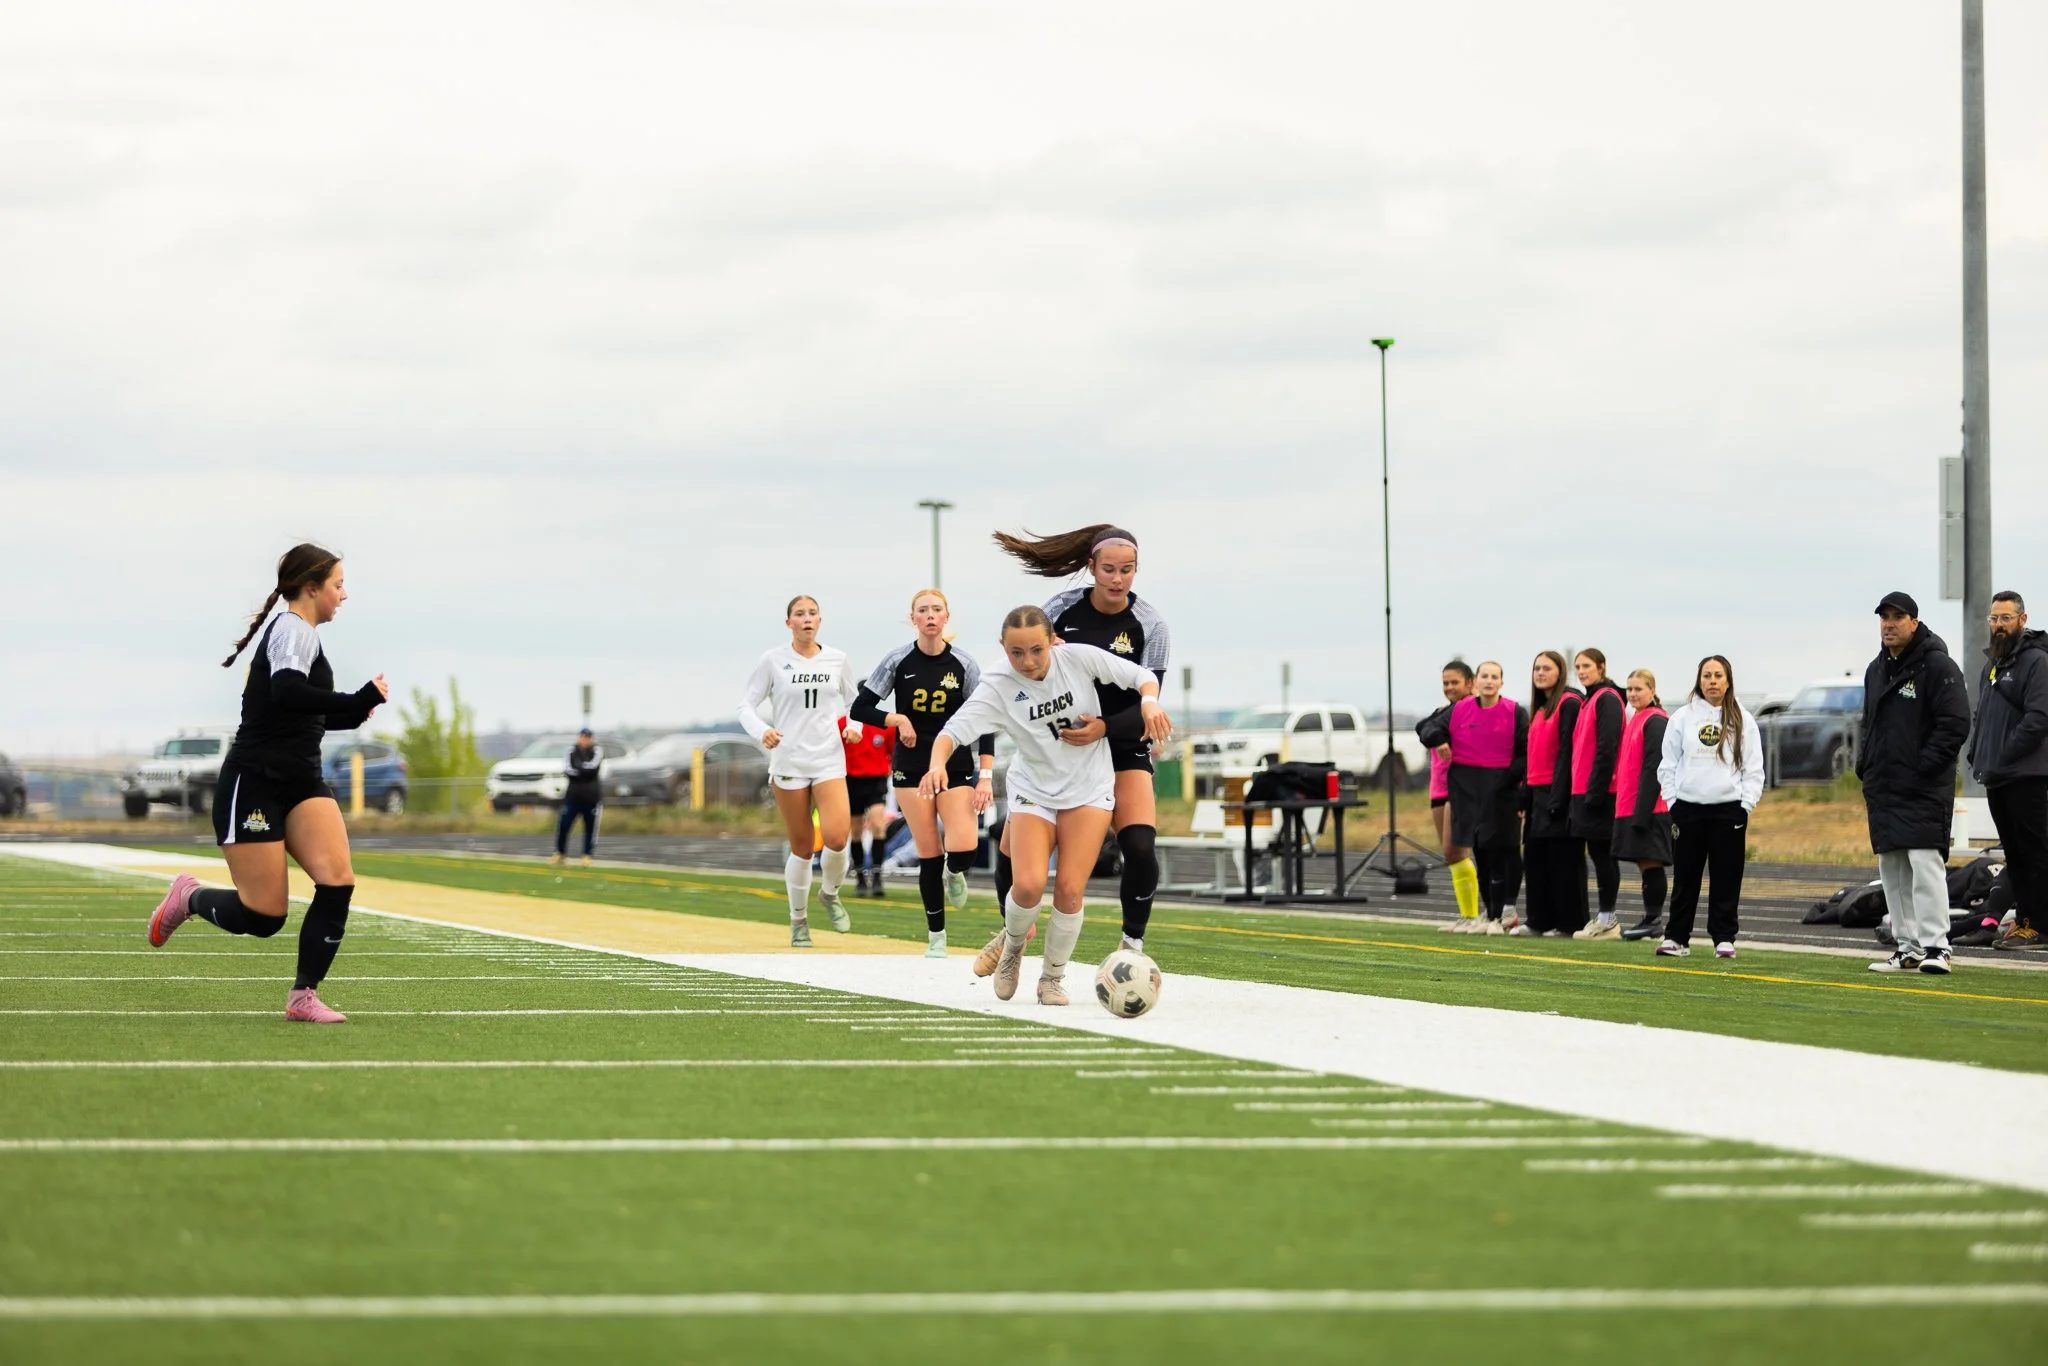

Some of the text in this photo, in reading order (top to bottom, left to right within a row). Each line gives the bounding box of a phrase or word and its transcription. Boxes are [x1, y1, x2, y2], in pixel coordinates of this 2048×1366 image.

[791, 673, 831, 684] LEGACY
[804, 688, 818, 709] 11
[912, 688, 947, 713] 22
[1029, 691, 1074, 721] LEGACY
